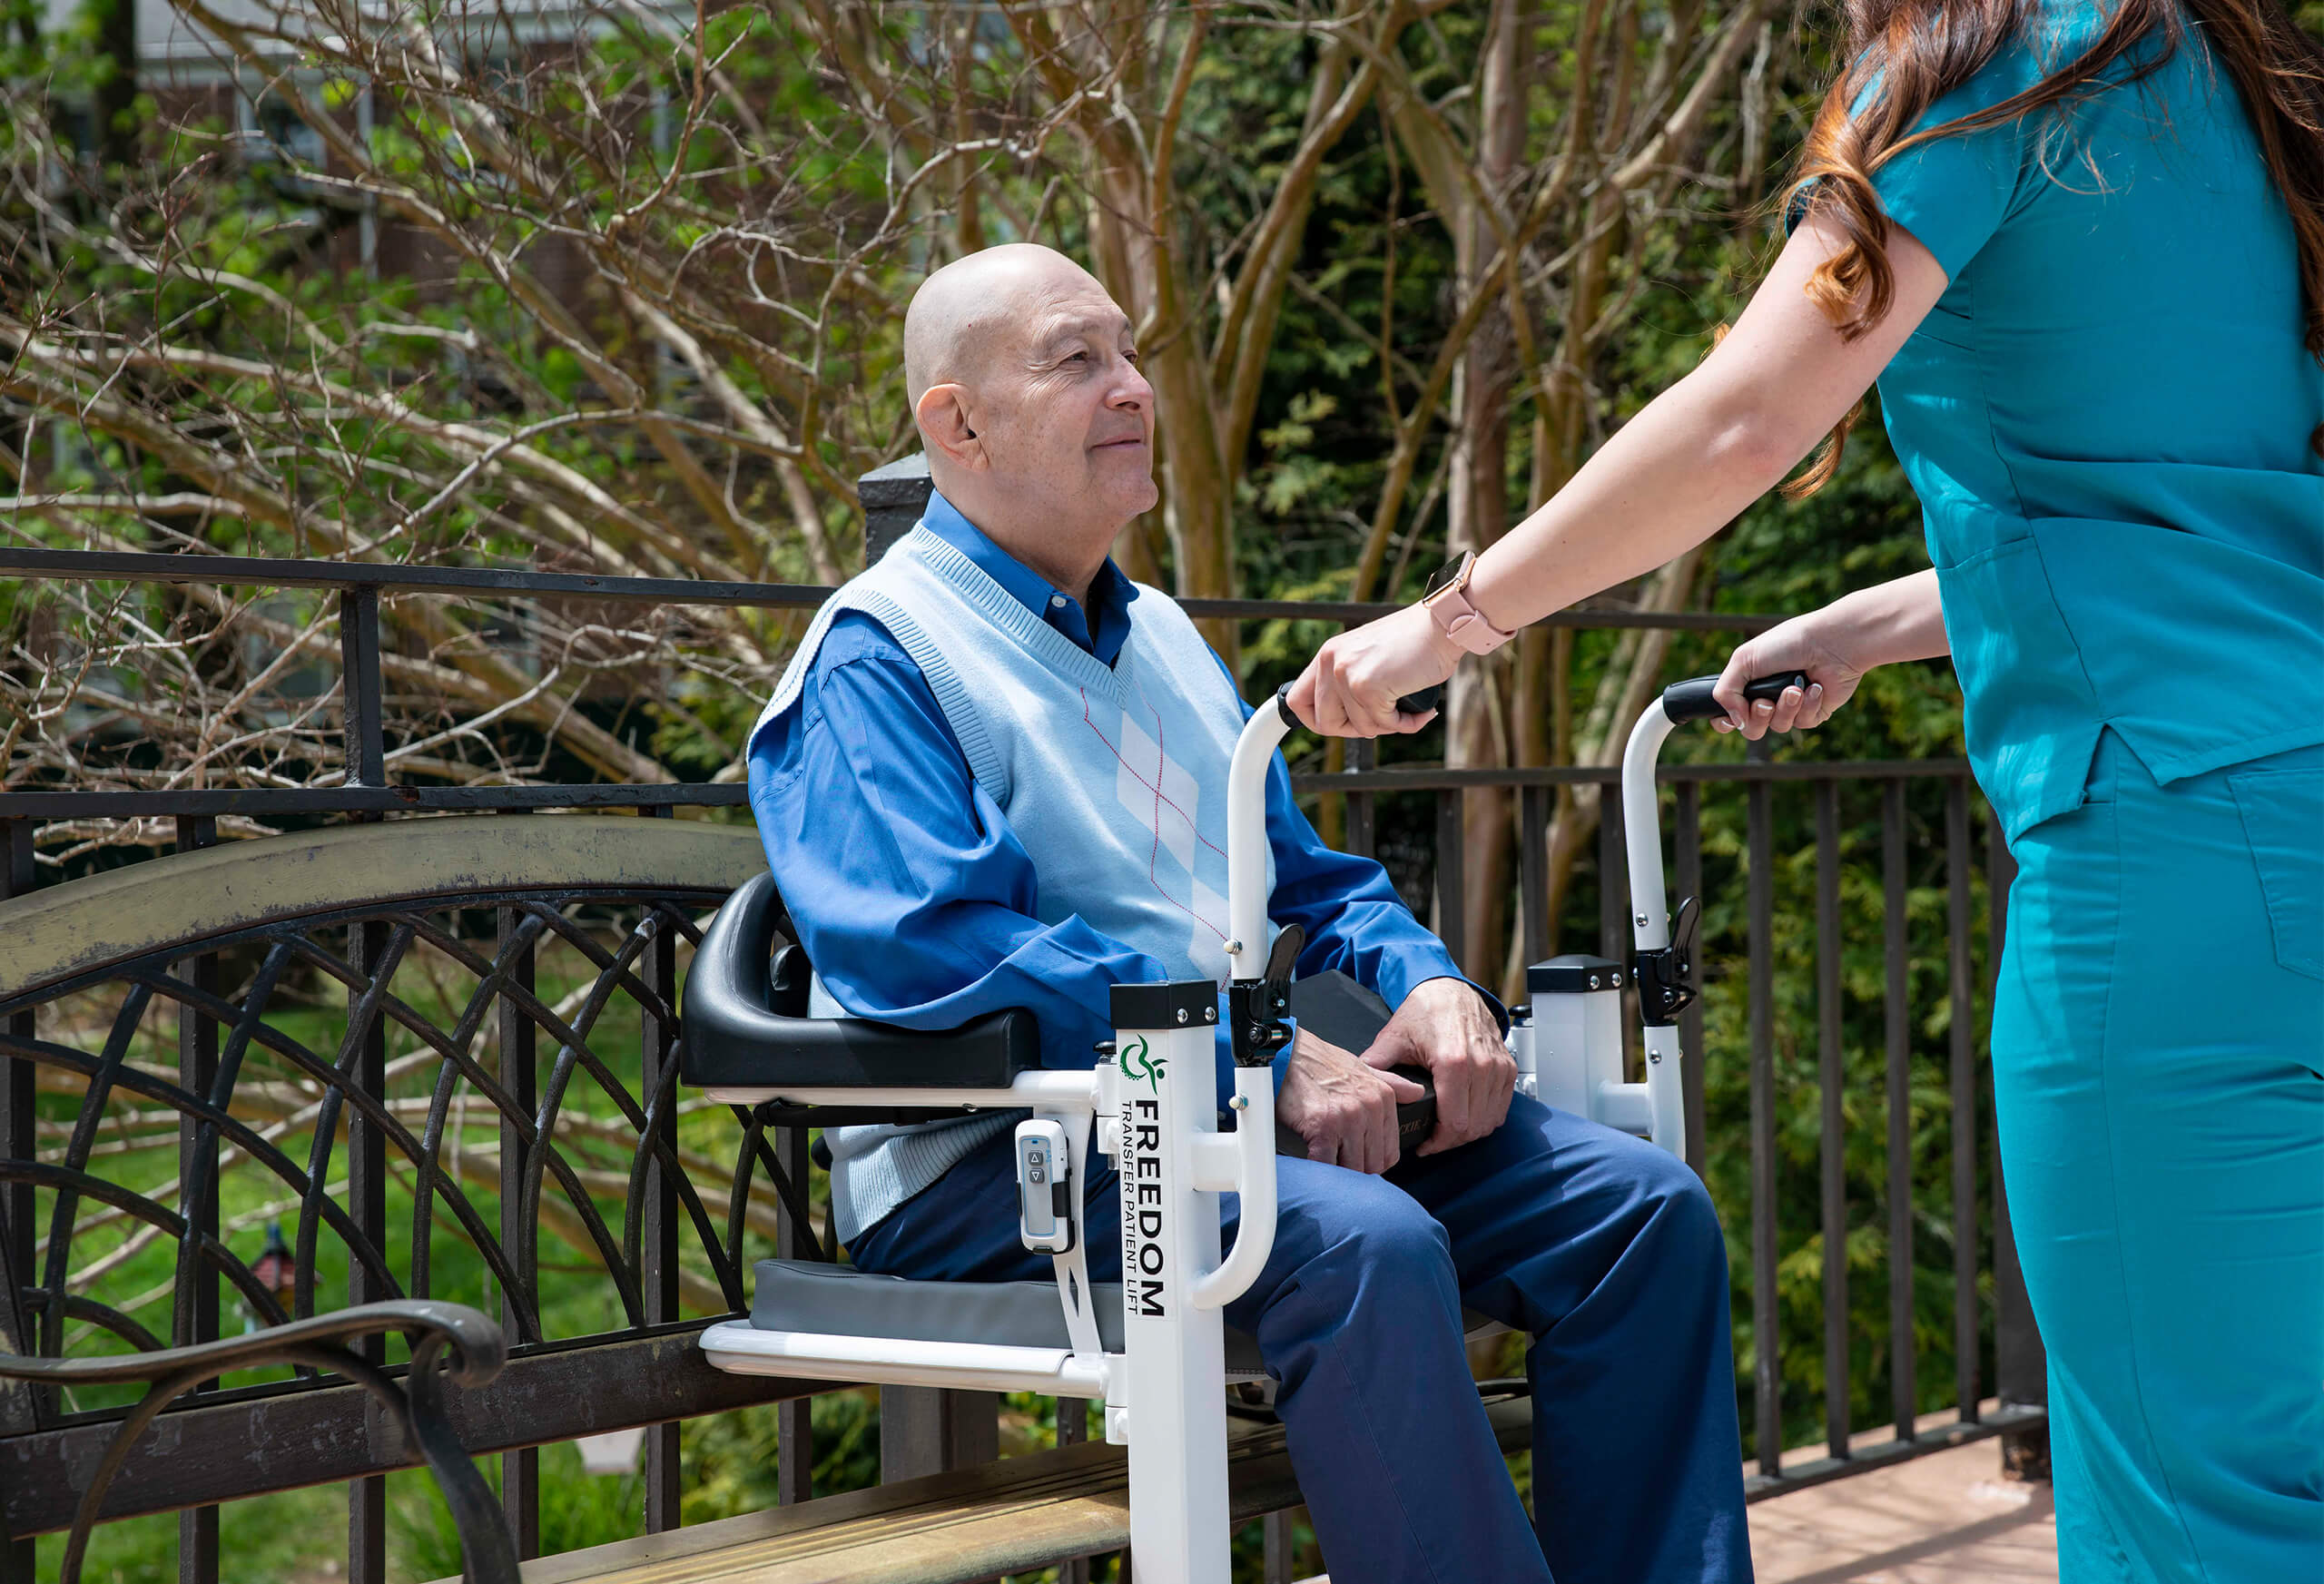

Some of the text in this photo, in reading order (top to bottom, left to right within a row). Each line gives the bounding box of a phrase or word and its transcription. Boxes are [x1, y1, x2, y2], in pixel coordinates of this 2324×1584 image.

[1121, 1099, 1138, 1315] TRANSFER PATIENT LIFT
[1135, 1099, 1165, 1317] FREEDOM
